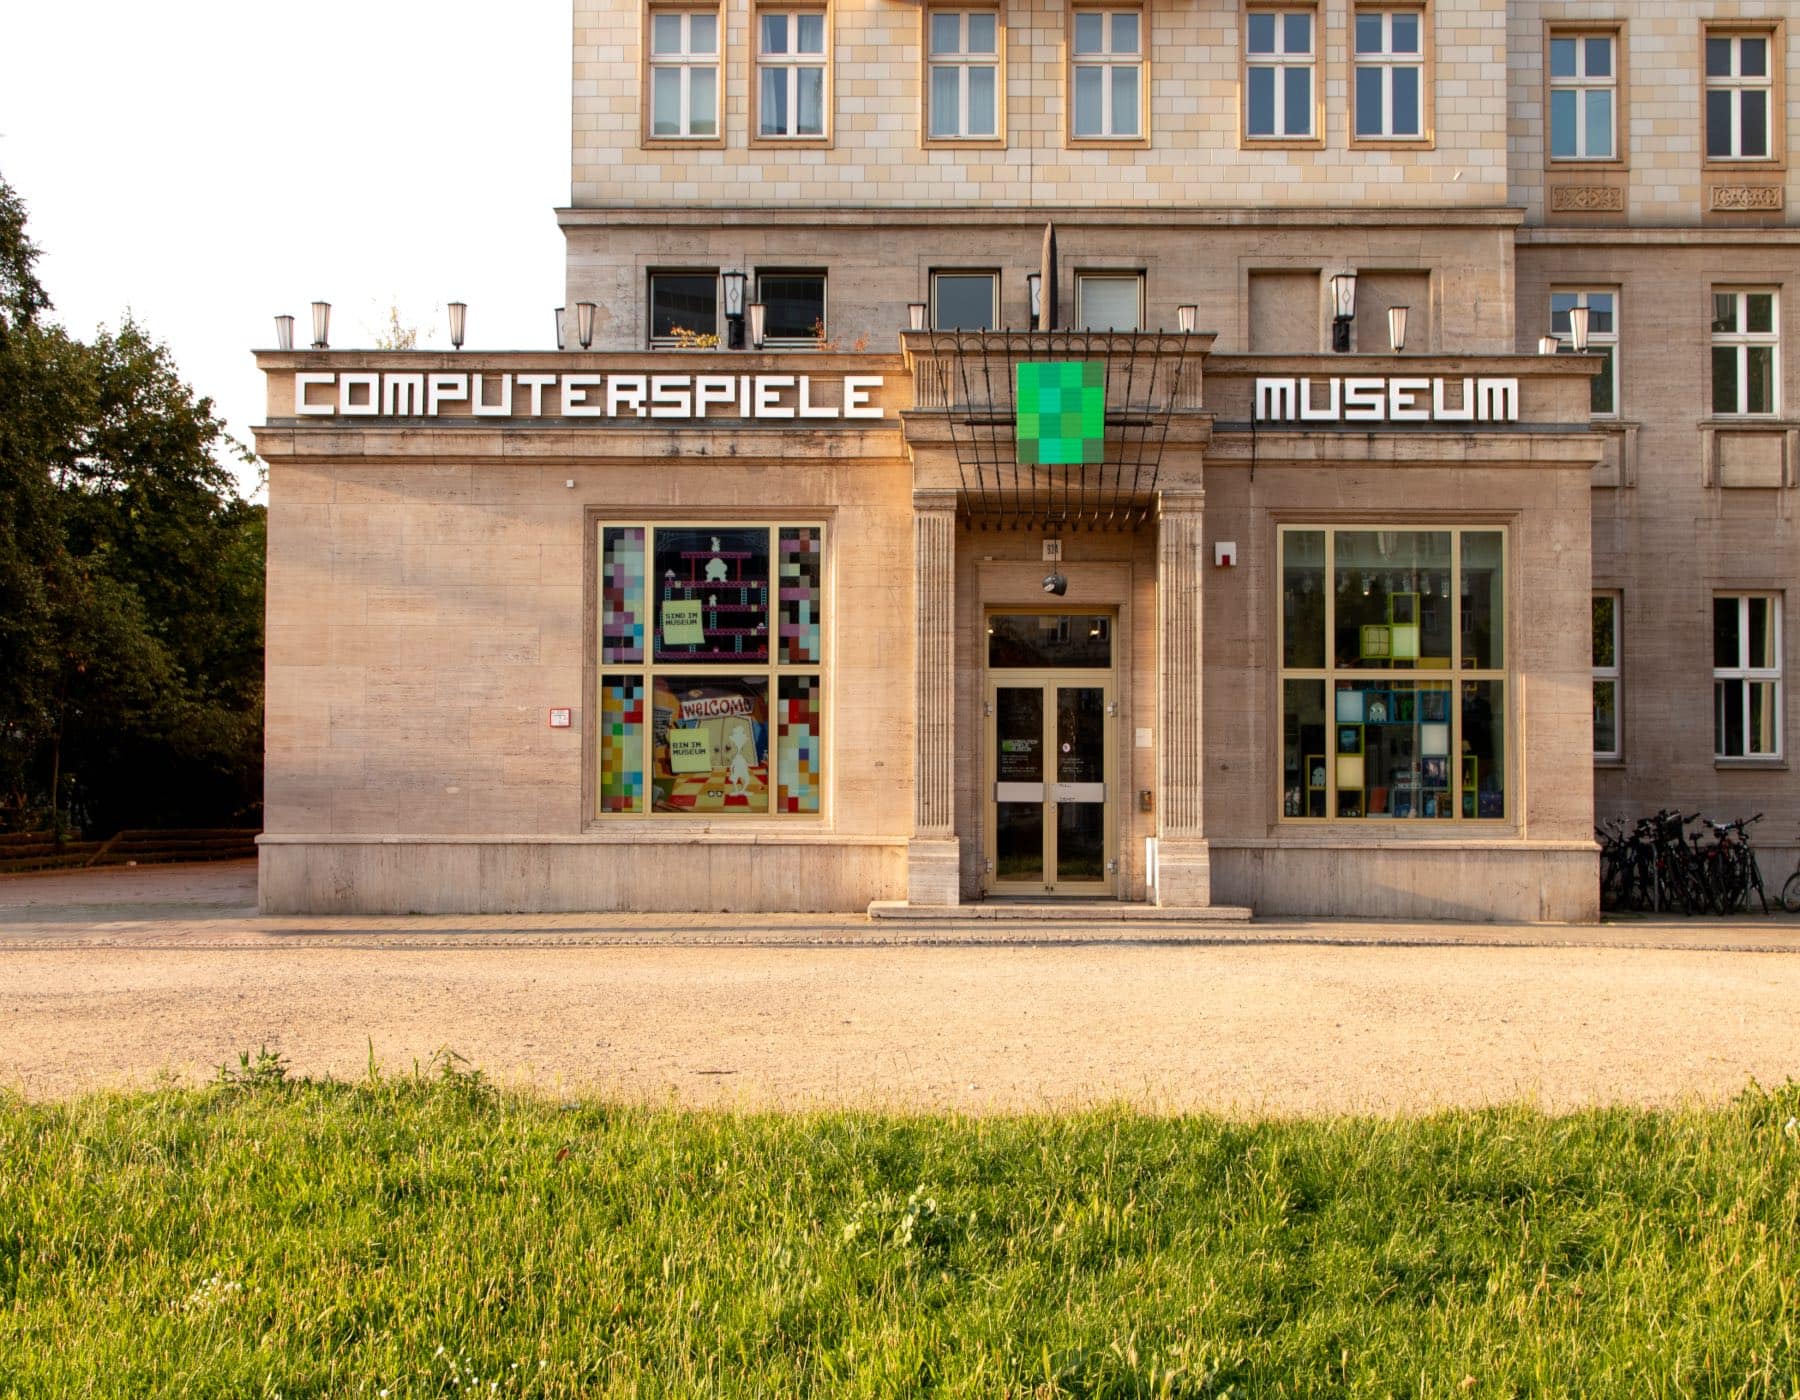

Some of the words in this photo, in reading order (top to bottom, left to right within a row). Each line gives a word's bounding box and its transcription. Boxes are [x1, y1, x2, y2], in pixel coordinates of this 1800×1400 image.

[295, 372, 884, 418] COMPUTERSPIELE
[1255, 377, 1519, 421] MUSEUM
[672, 748, 706, 756] MUSEUM
